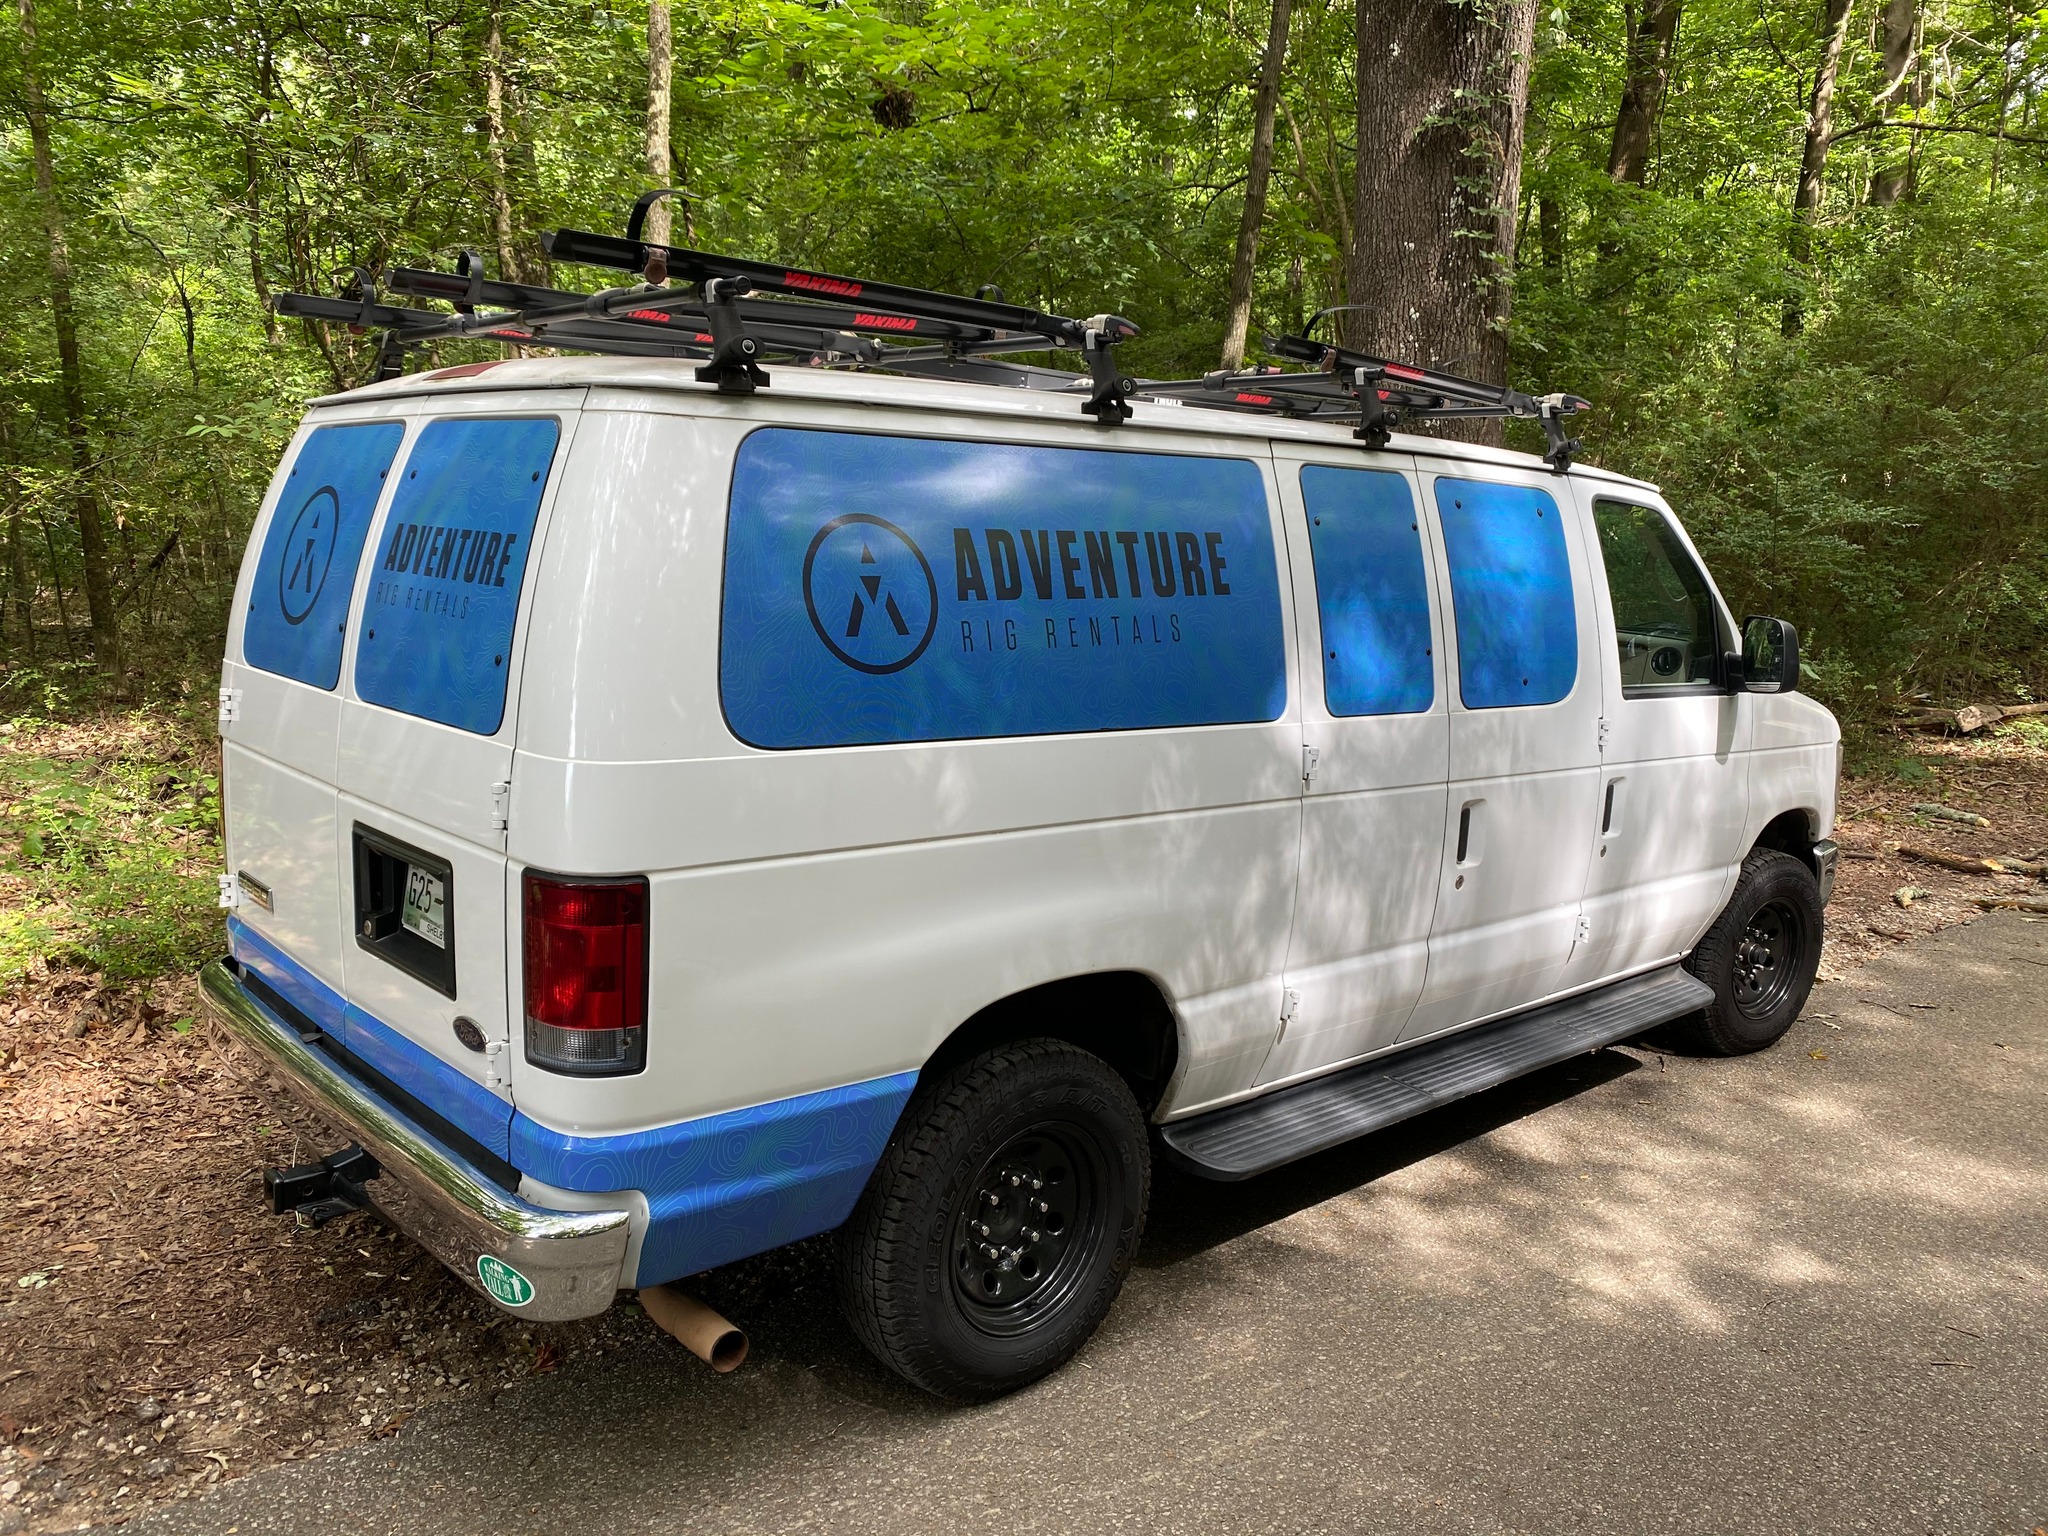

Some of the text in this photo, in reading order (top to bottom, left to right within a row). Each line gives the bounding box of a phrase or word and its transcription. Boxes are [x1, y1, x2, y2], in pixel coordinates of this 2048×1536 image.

[783, 271, 863, 298] YAKIMA
[852, 312, 918, 331] YAKIMA
[383, 523, 518, 588] ADVENTURE
[953, 527, 1231, 602] ADVENTURE
[375, 582, 469, 620] RIG RENTALS
[960, 613, 1182, 653] RIG RENTALS
[426, 923, 445, 941] SHELB
